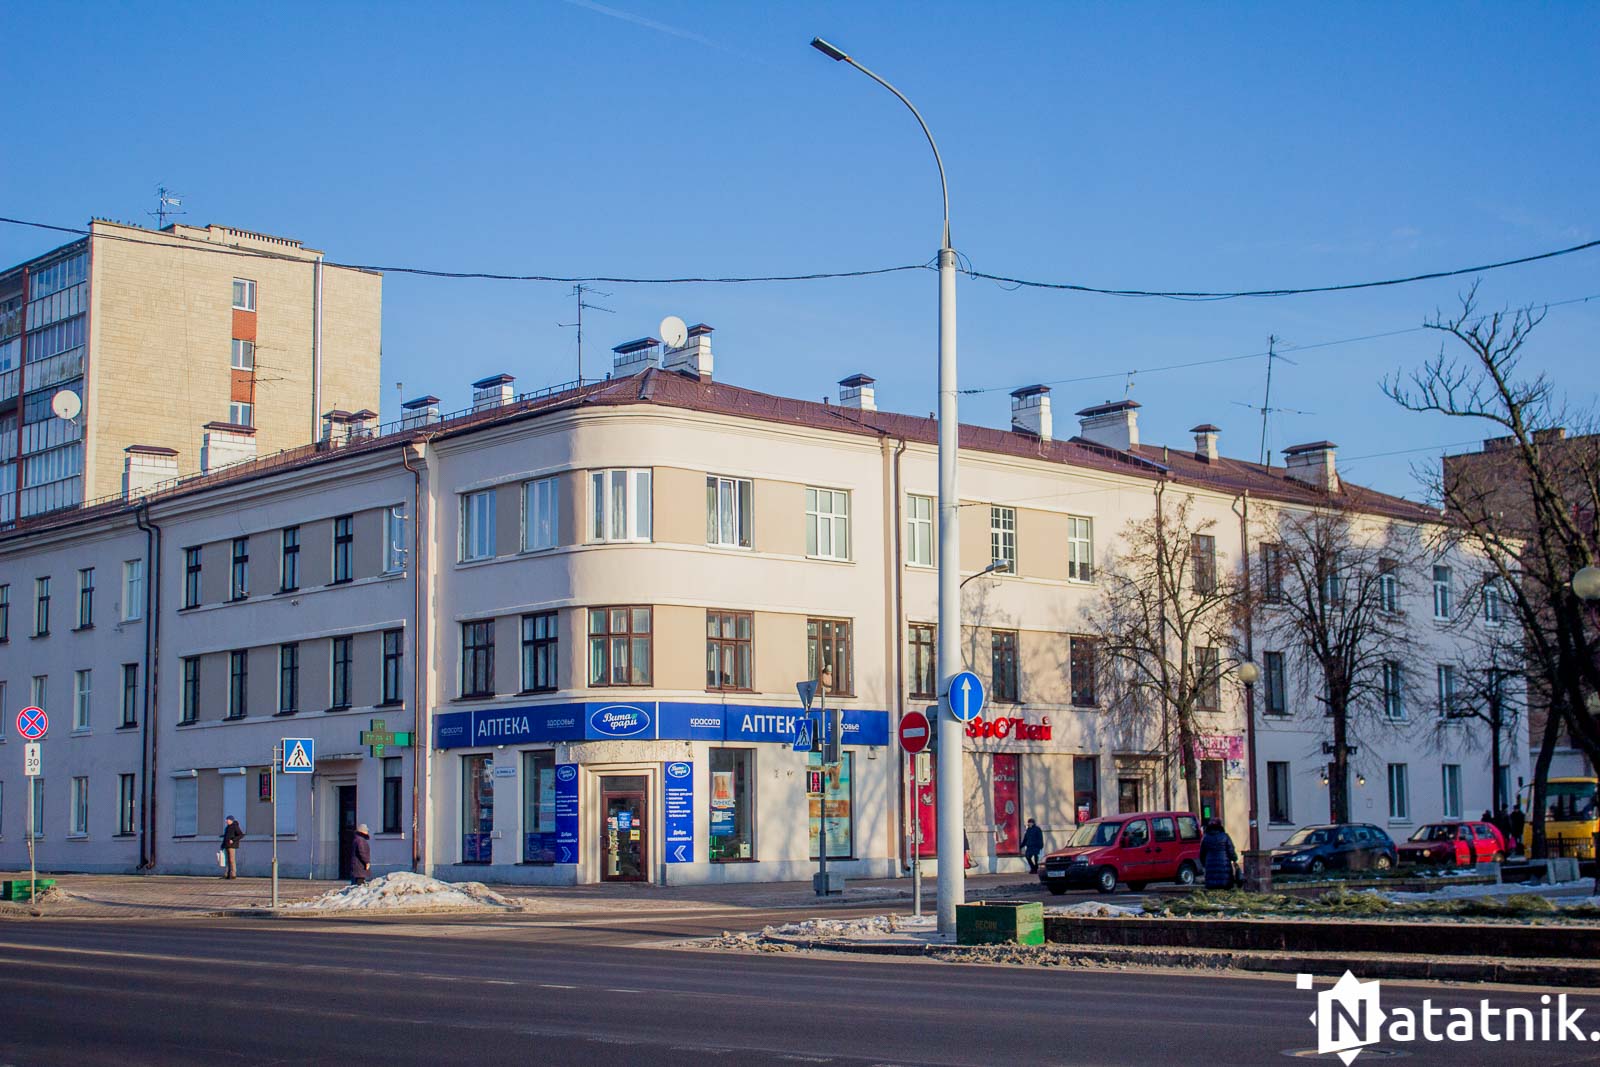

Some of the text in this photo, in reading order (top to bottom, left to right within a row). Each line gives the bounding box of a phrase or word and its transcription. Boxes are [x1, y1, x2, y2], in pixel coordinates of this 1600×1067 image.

[546, 718, 575, 728] здоровье
[602, 712, 631, 723] Вита
[690, 718, 720, 727] красота
[478, 716, 530, 737] АПТЕКА
[610, 719, 638, 730] фарм
[741, 714, 804, 734] АПТЕК
[27, 758, 39, 766] 30
